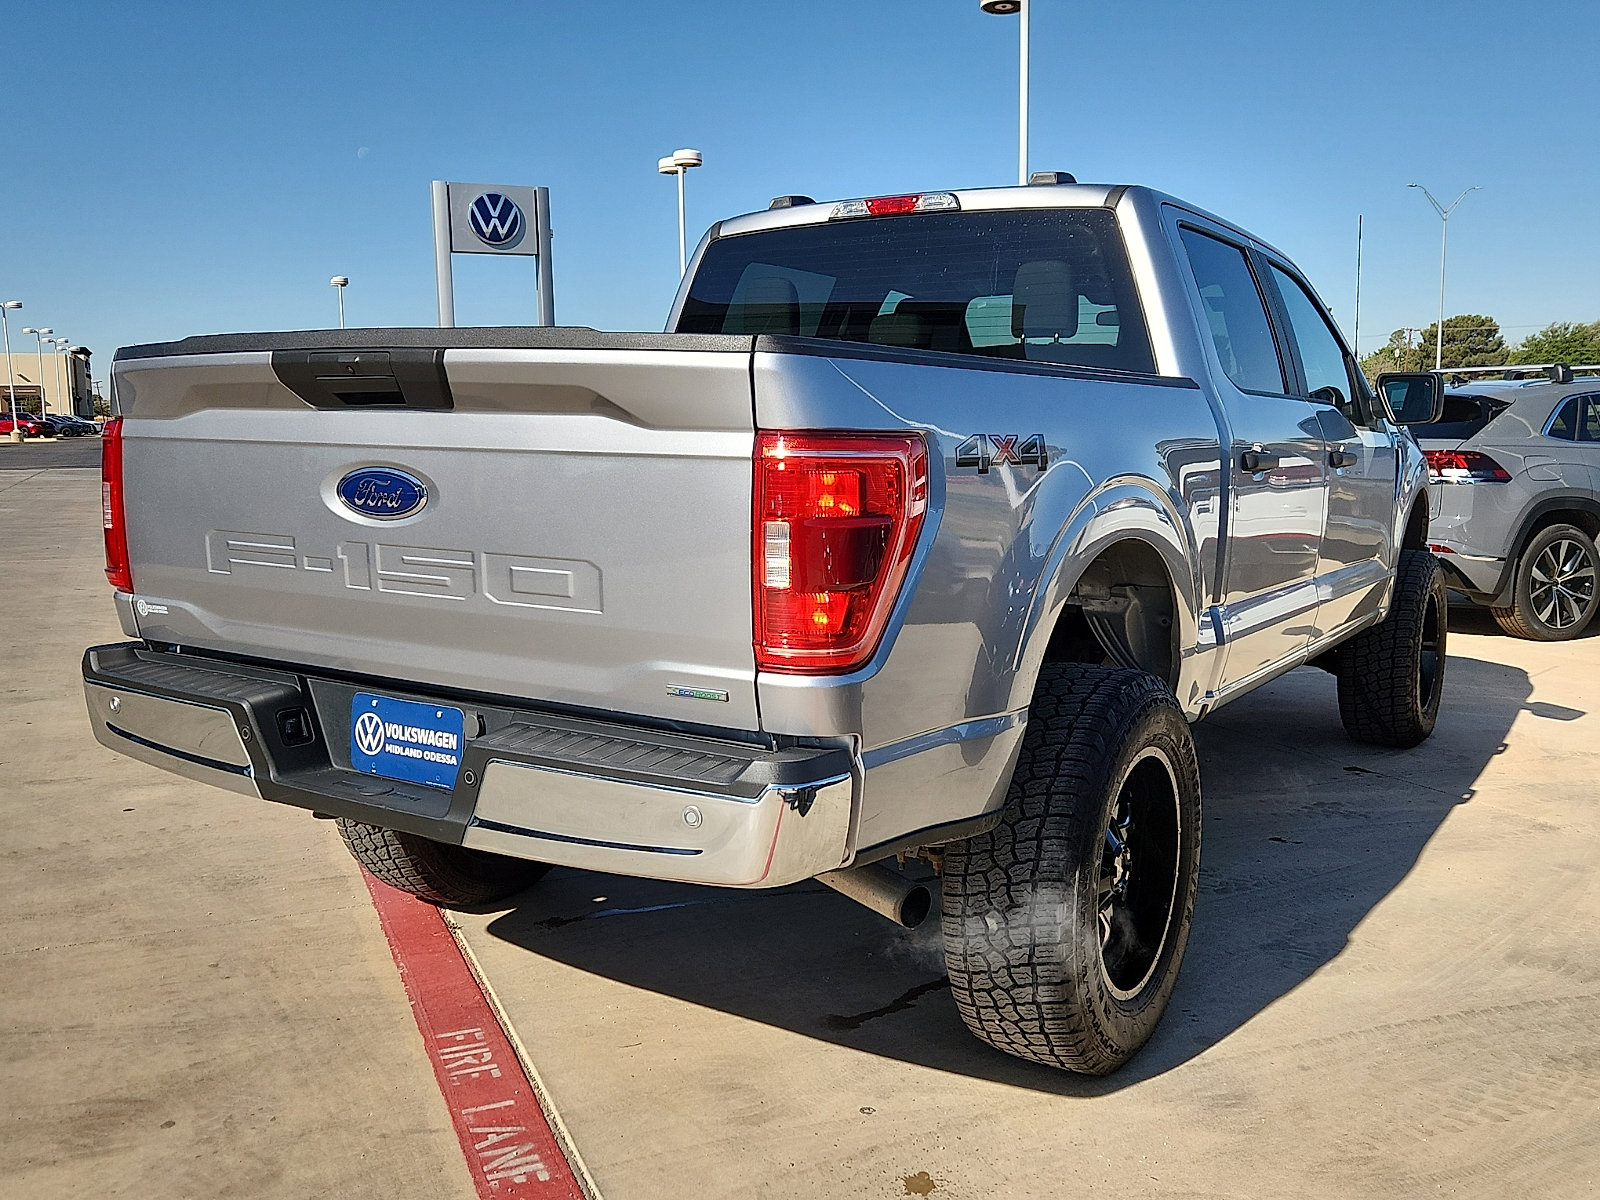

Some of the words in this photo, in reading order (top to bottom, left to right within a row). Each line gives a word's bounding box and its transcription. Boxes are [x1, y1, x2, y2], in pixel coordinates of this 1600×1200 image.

[354, 477, 403, 508] Ford
[205, 529, 604, 615] F-150
[385, 722, 458, 750] VOLKSWAGEN
[385, 743, 423, 759] MIDLAND
[423, 750, 458, 766] ODESSA
[436, 1028, 501, 1086] FIRE
[462, 1099, 550, 1189] LANE
